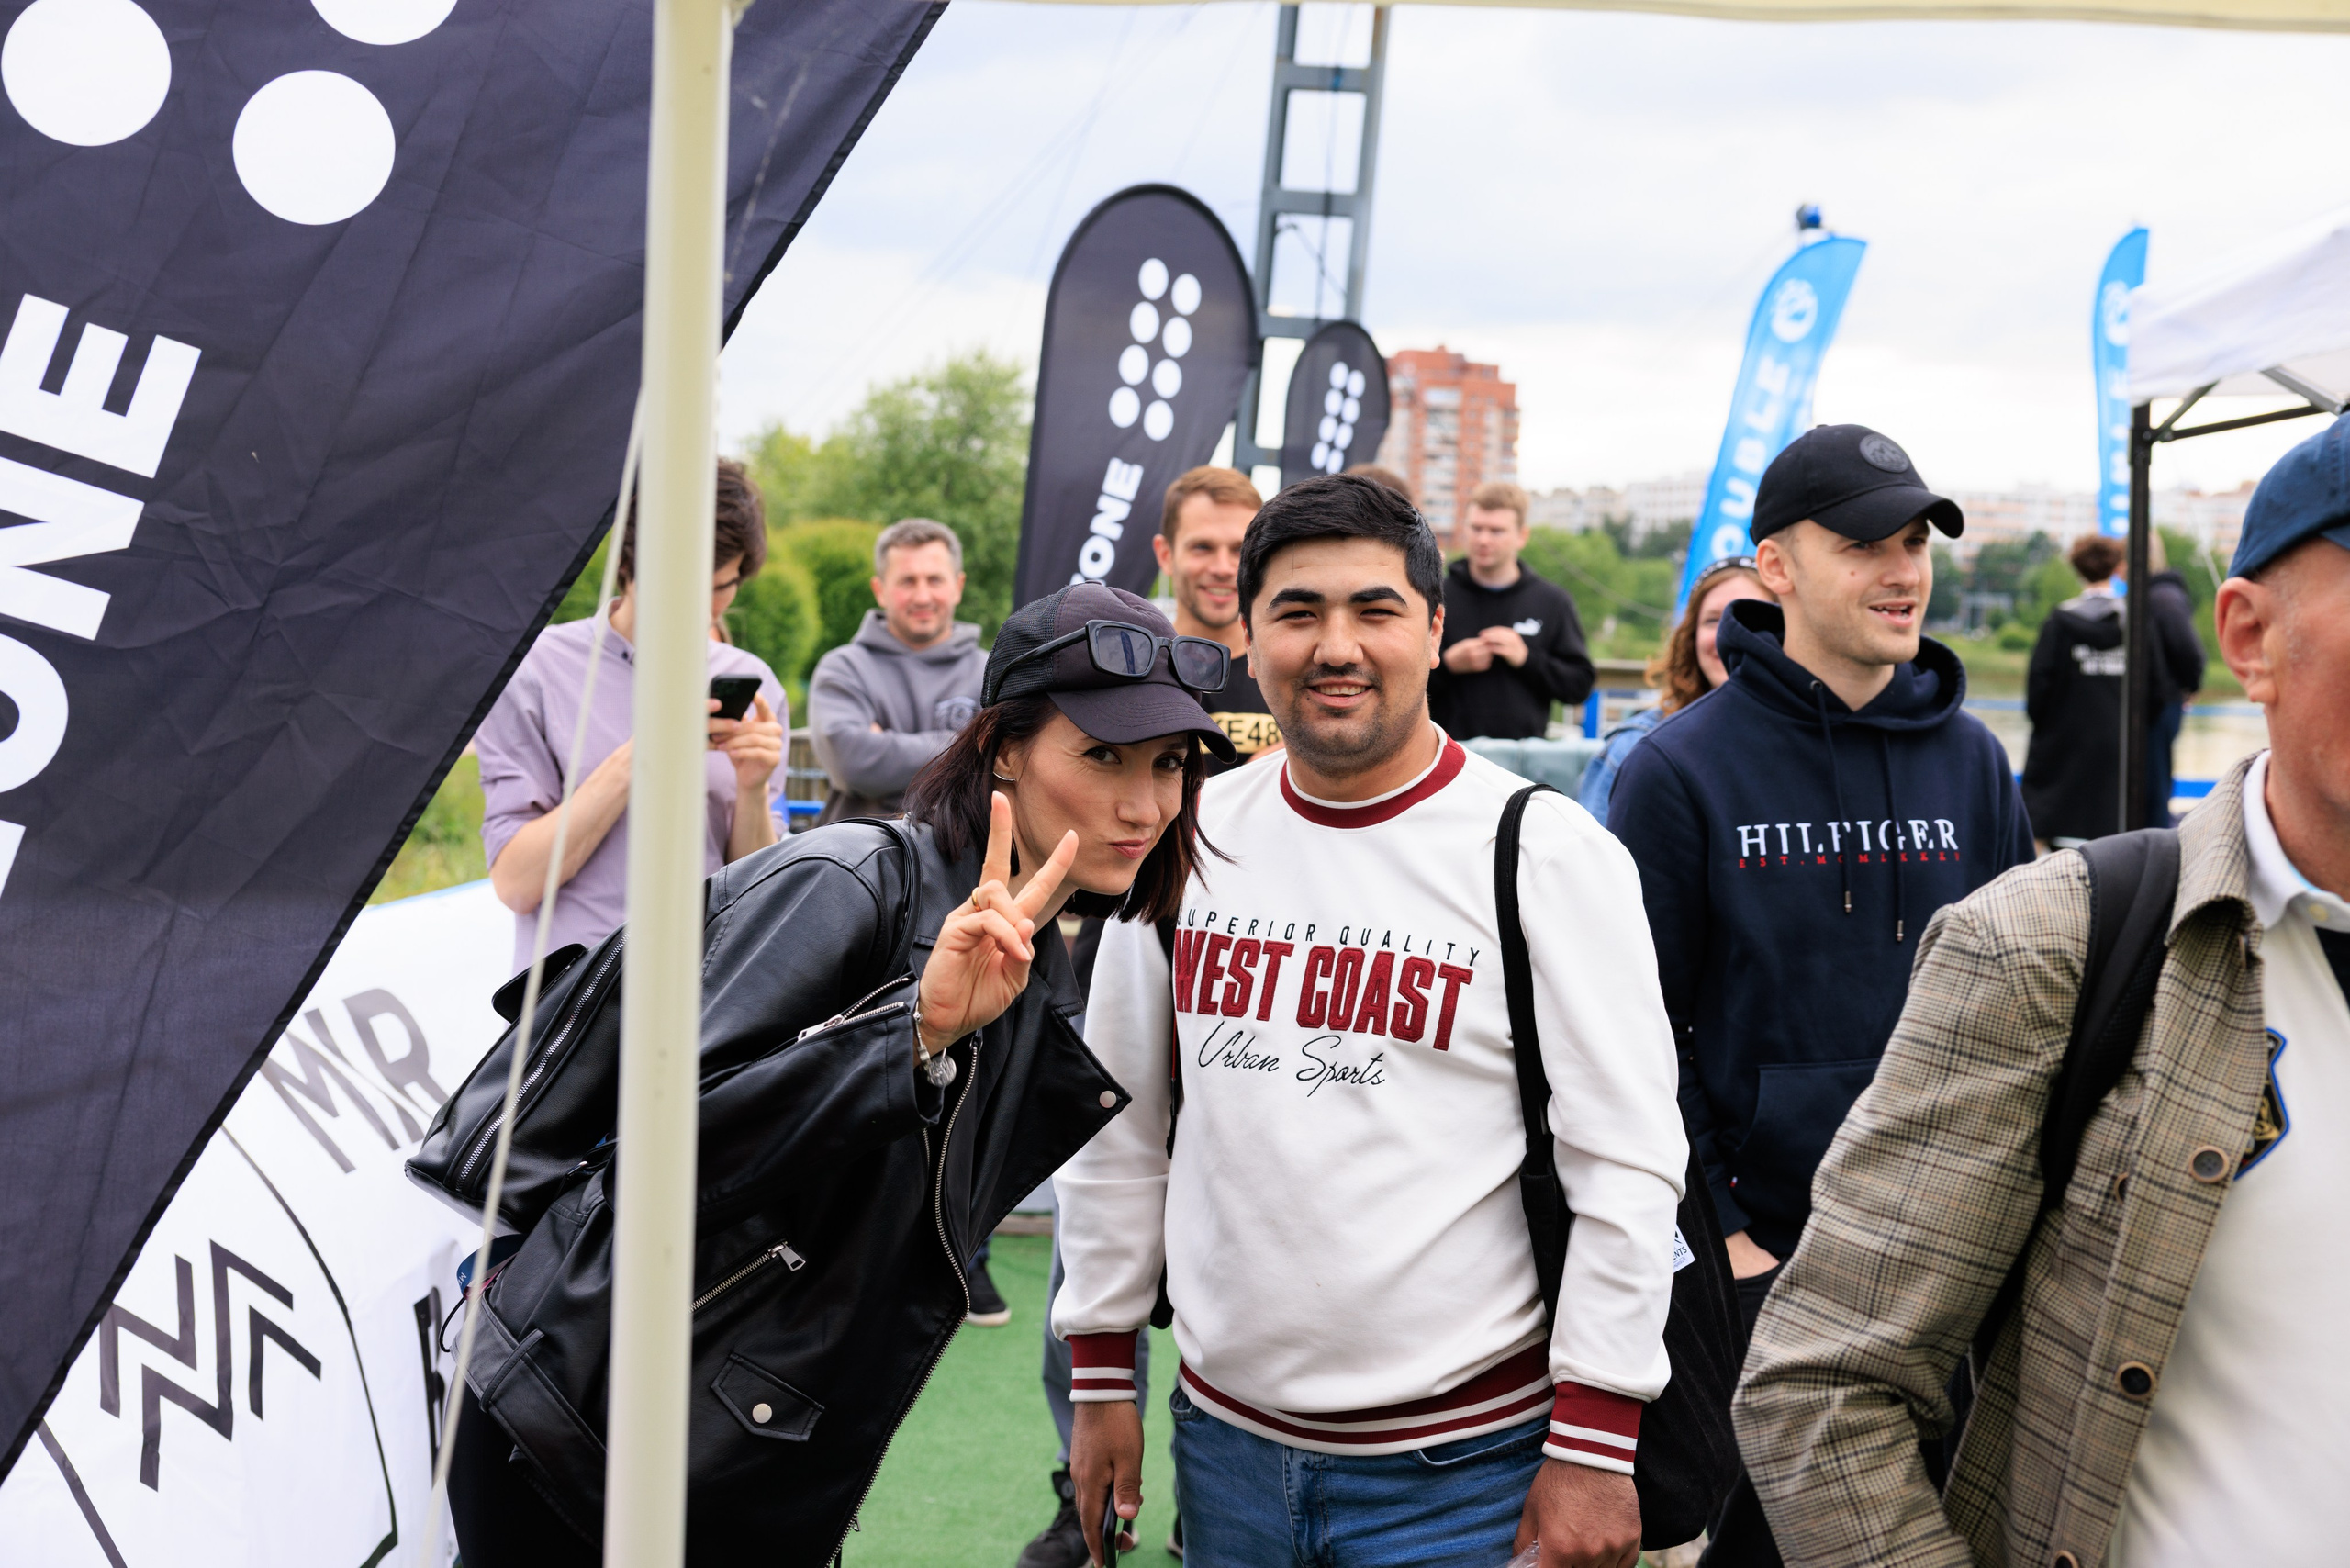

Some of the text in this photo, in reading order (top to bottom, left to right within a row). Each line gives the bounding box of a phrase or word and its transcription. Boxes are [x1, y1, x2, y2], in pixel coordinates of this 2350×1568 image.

[1711, 354, 1791, 560] OUBLE
[1069, 457, 1144, 587] ONE
[1736, 818, 1959, 857] HILFIGER
[1174, 928, 1474, 1051] WEST COAST
[1339, 925, 1480, 967] QUALITY
[1198, 1020, 1385, 1097] Urban Sports
